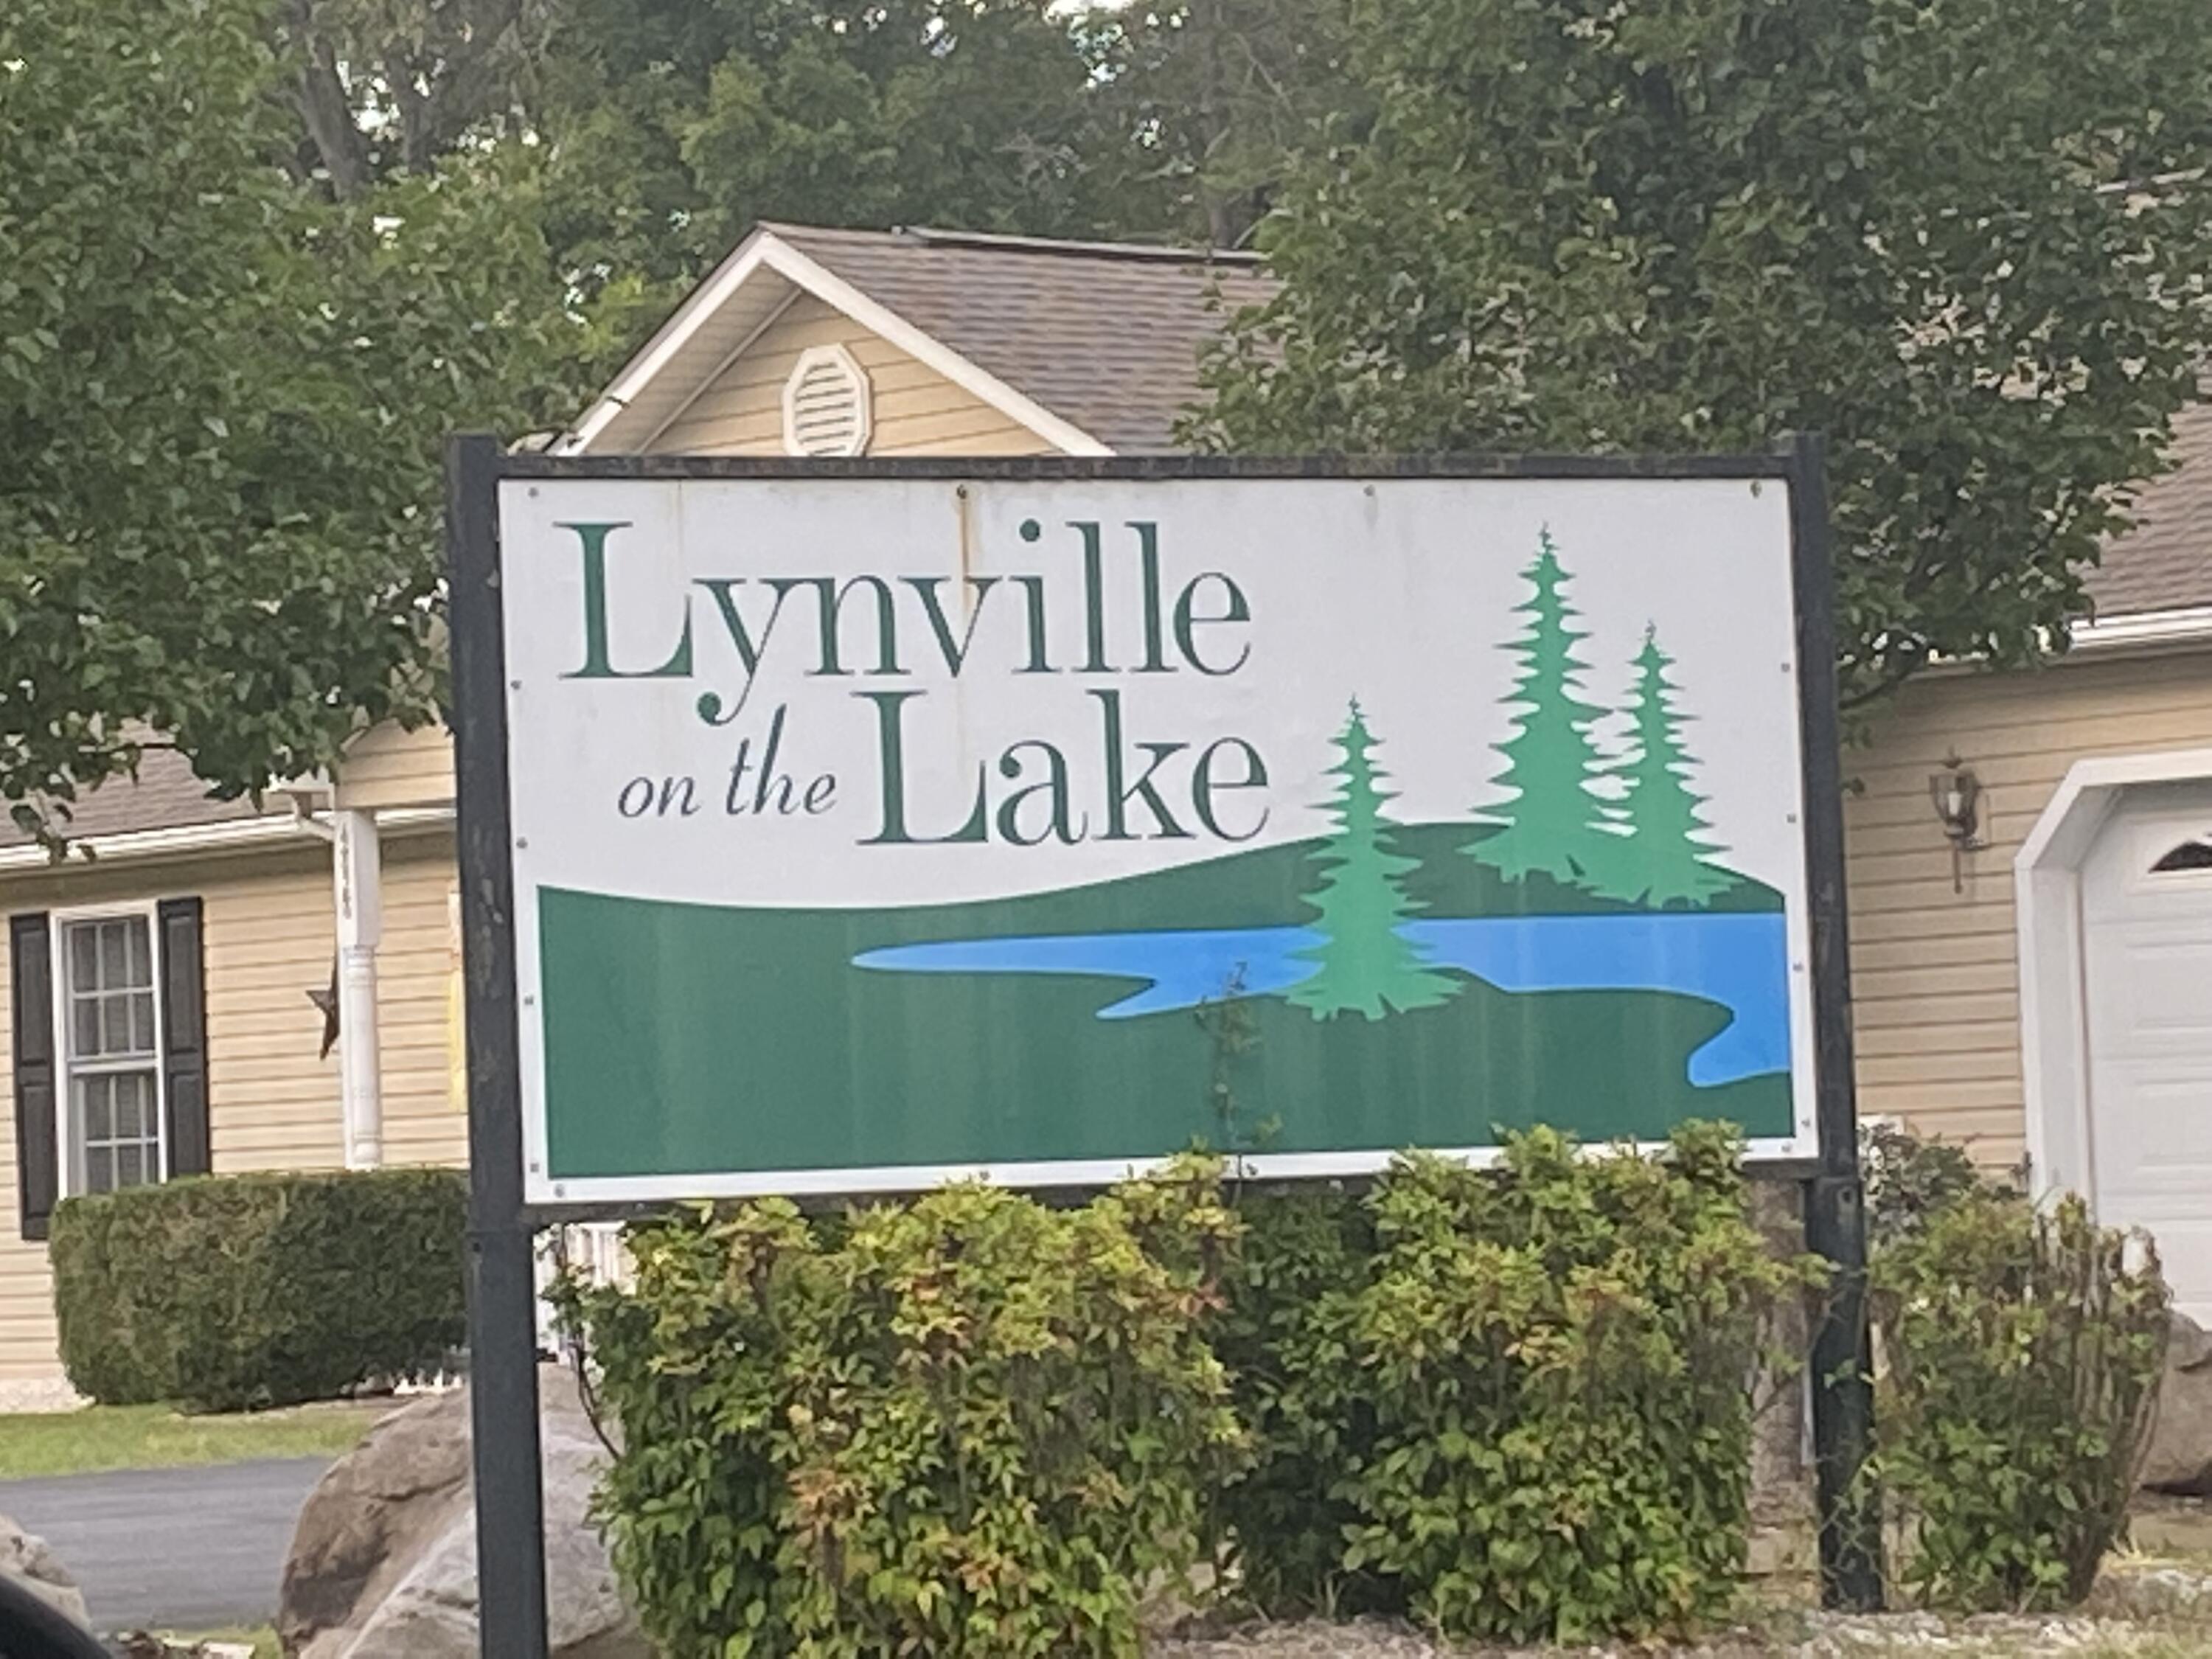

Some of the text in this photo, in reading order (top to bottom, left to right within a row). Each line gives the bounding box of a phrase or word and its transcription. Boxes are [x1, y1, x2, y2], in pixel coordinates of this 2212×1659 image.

[554, 519, 1251, 726] Lynville
[618, 689, 1270, 846] on the Lake
